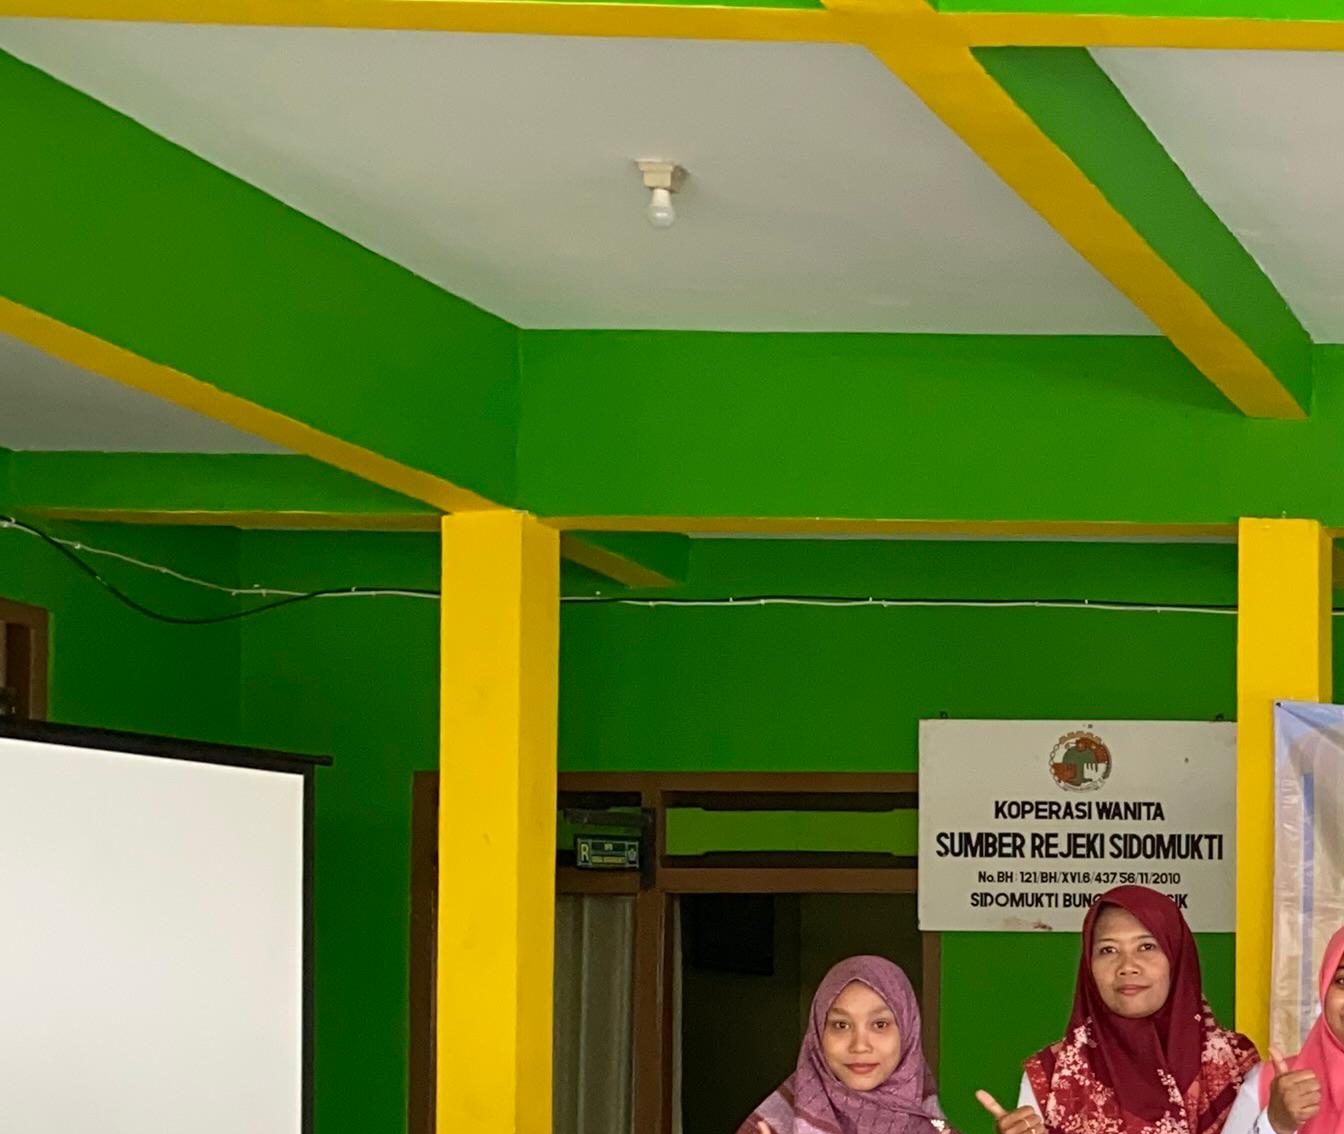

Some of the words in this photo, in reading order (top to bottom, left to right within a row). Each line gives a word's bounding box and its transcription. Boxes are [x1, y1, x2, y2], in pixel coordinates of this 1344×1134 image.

[994, 800, 1092, 820] KOPERASI
[1095, 801, 1165, 821] WANITA
[936, 832, 1026, 858] SUMBER
[1031, 832, 1105, 859] REJEKI
[1109, 833, 1224, 860] SIDOMUKTI
[970, 892, 1059, 908] SIDOMUKTI
